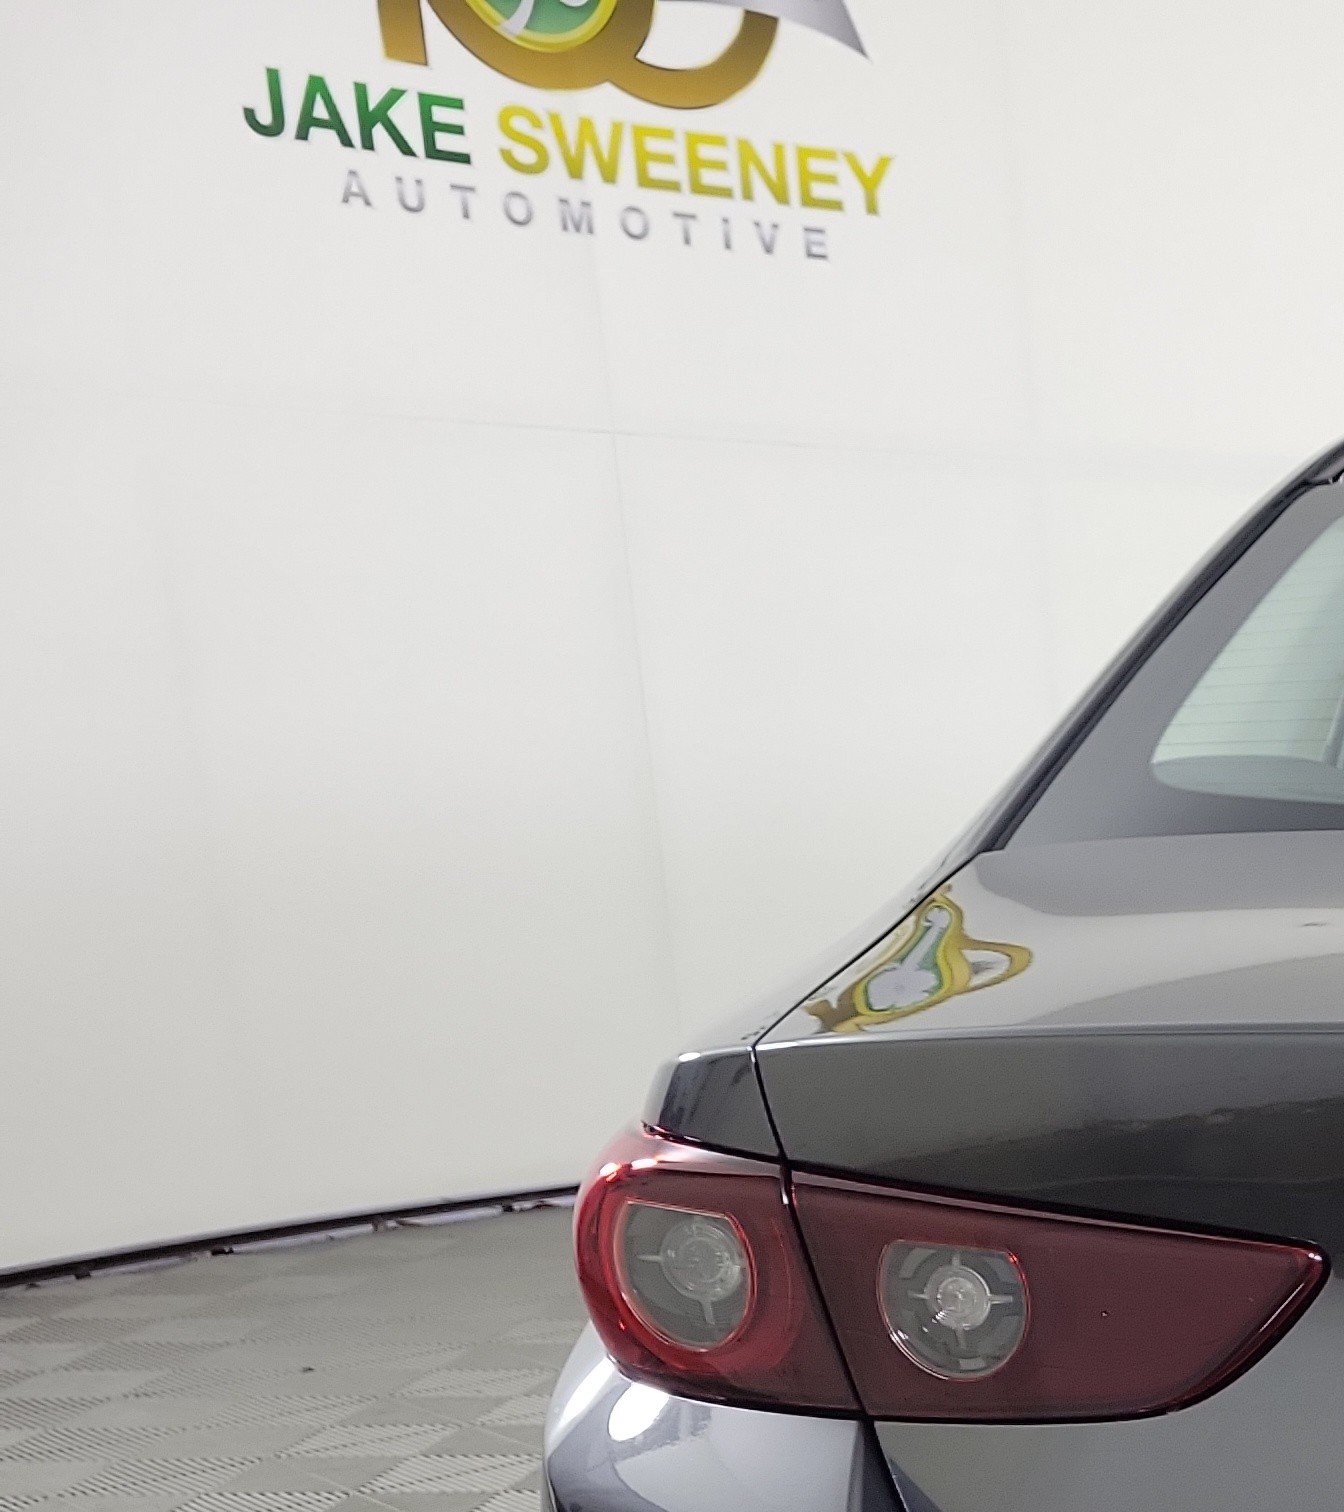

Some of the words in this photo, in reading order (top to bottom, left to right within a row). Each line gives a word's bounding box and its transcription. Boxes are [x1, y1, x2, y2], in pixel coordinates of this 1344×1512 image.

[242, 66, 472, 165] JAKE
[497, 105, 894, 216] SWEENEY
[341, 169, 829, 260] AUTOMOTIVE
